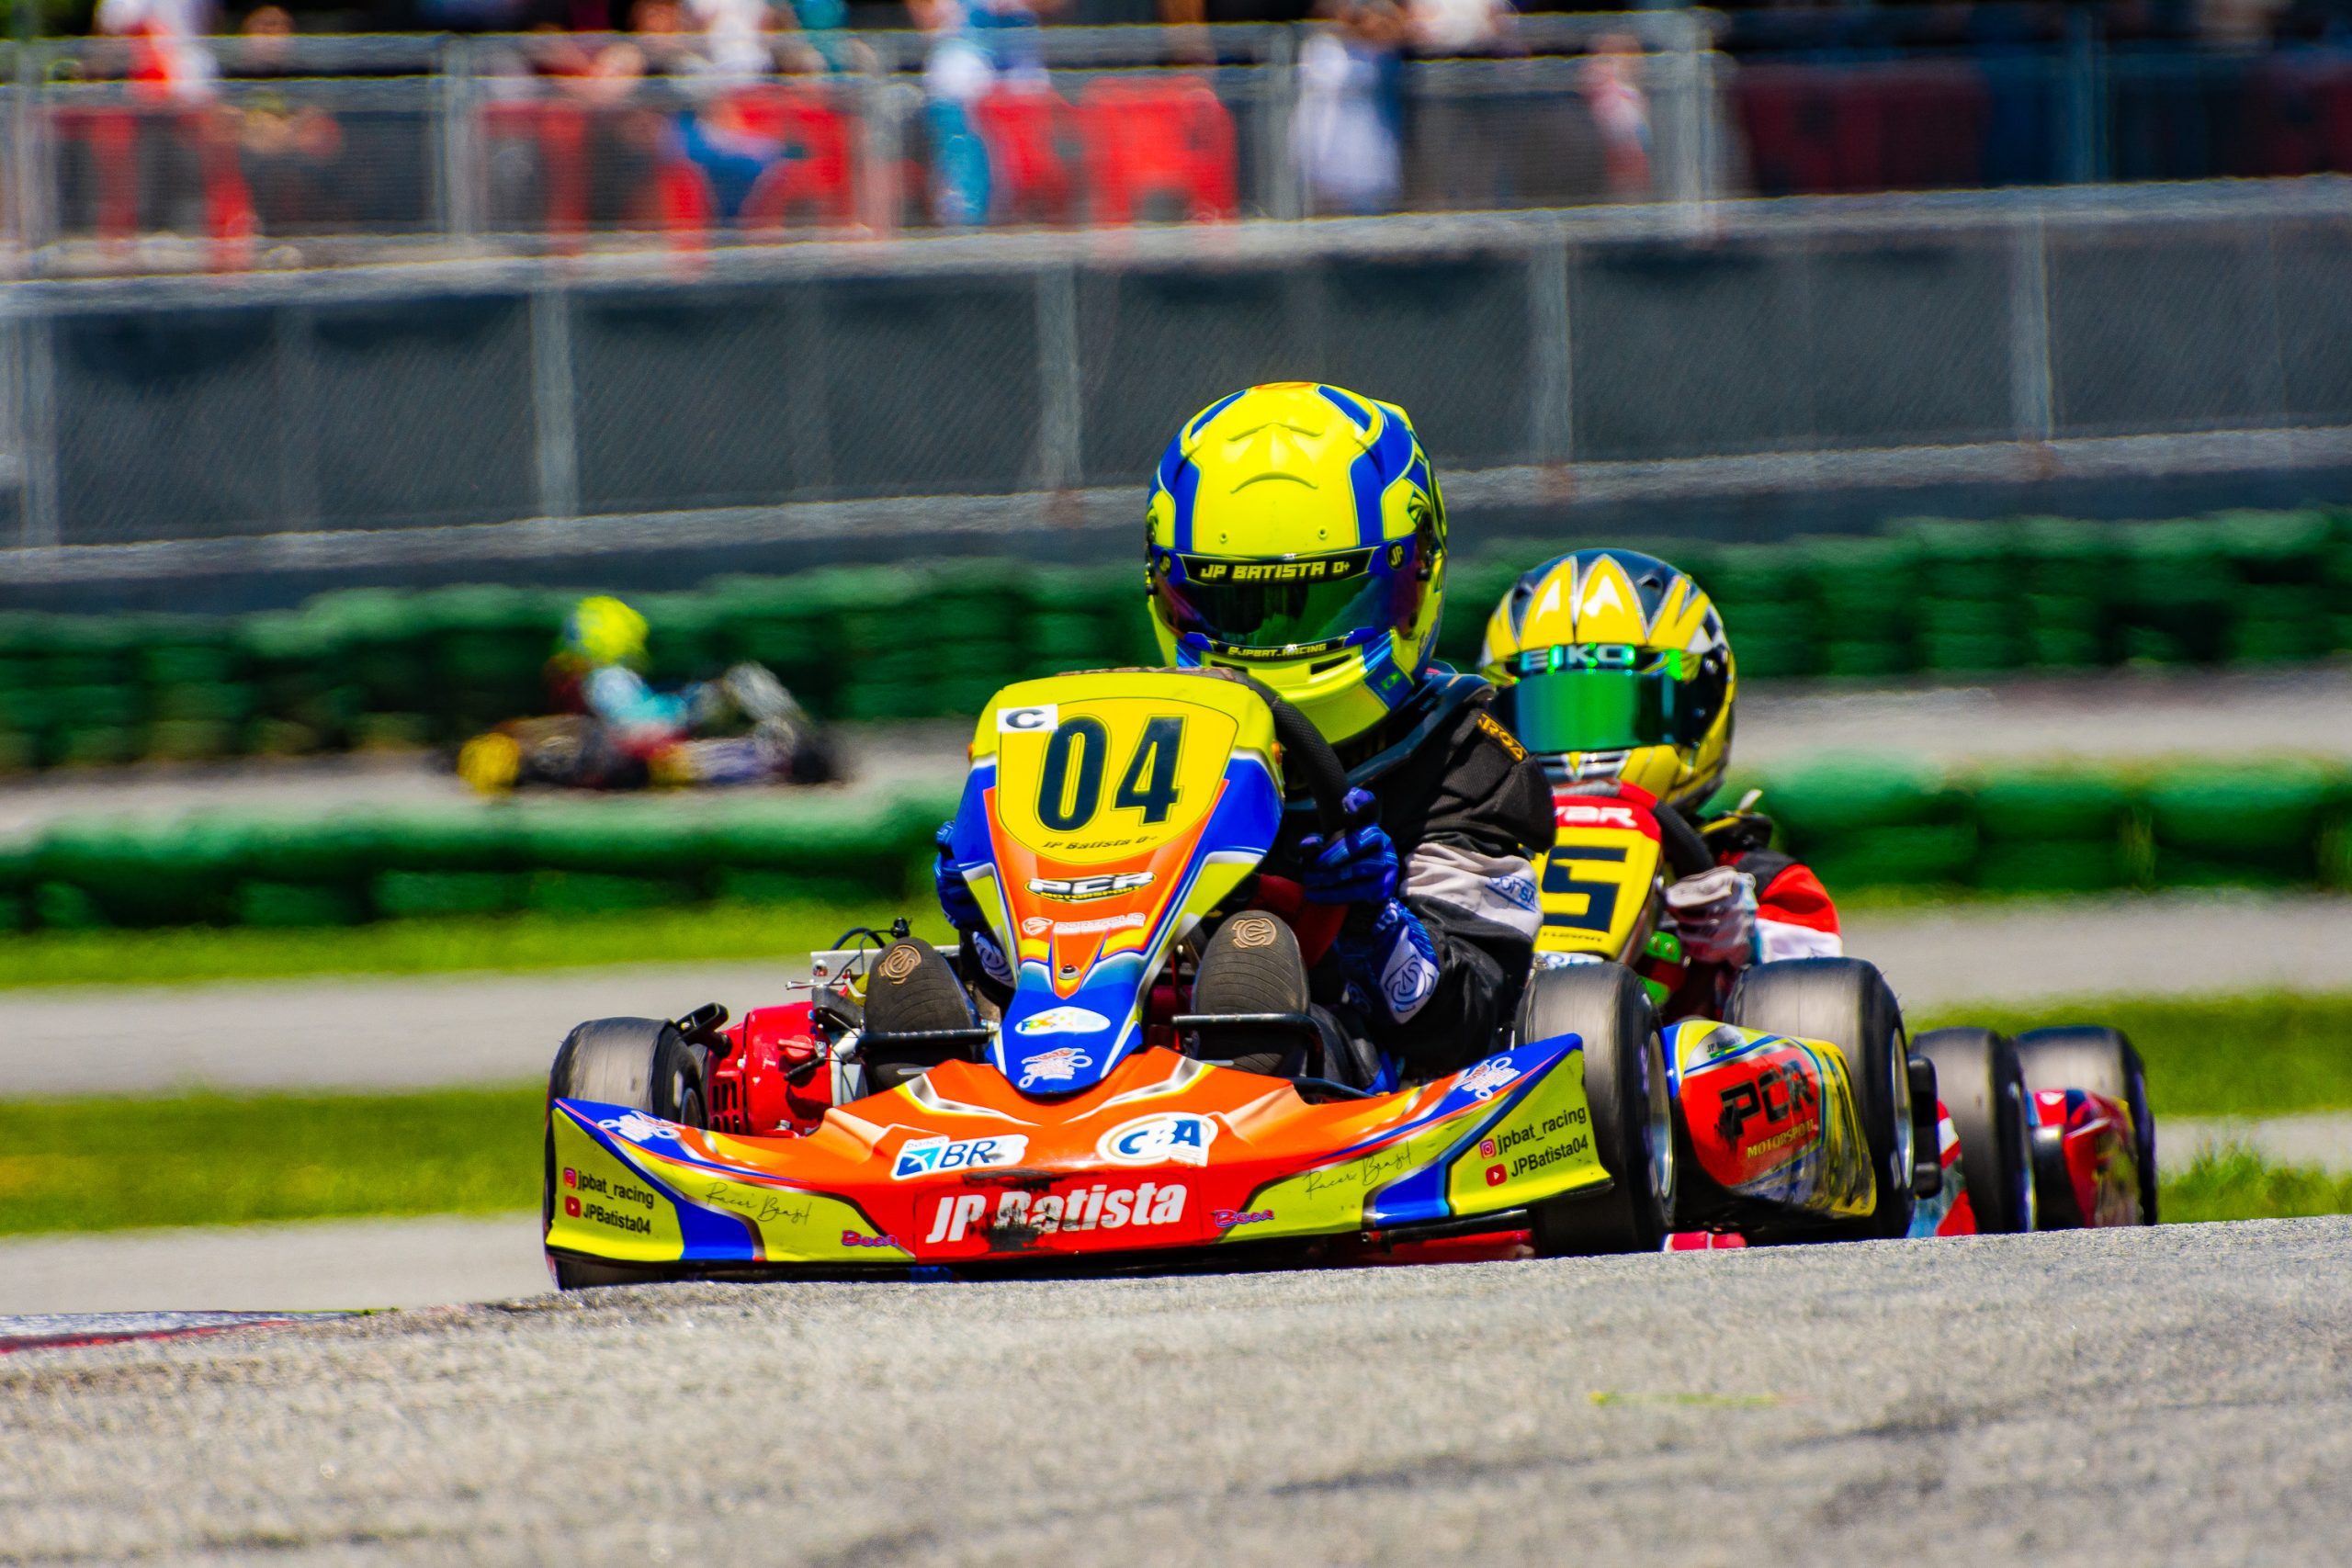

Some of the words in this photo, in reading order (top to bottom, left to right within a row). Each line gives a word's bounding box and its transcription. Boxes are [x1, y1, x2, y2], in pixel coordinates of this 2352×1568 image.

[1200, 565, 1227, 580] JP
[1232, 561, 1326, 580] BATISTA
[1005, 708, 1046, 729] C
[1035, 713, 1186, 832] 04
[1029, 872, 1155, 895] PCR
[1040, 886, 1141, 900] MOTORSPORT
[1498, 1107, 1588, 1156] jpbat_racing
[1511, 1134, 1589, 1177] JPBatista04
[577, 1170, 654, 1210] jpbat_racing
[583, 1203, 651, 1235] JPBatista04
[925, 1195, 986, 1244] JP
[993, 1182, 1188, 1235] Batista
